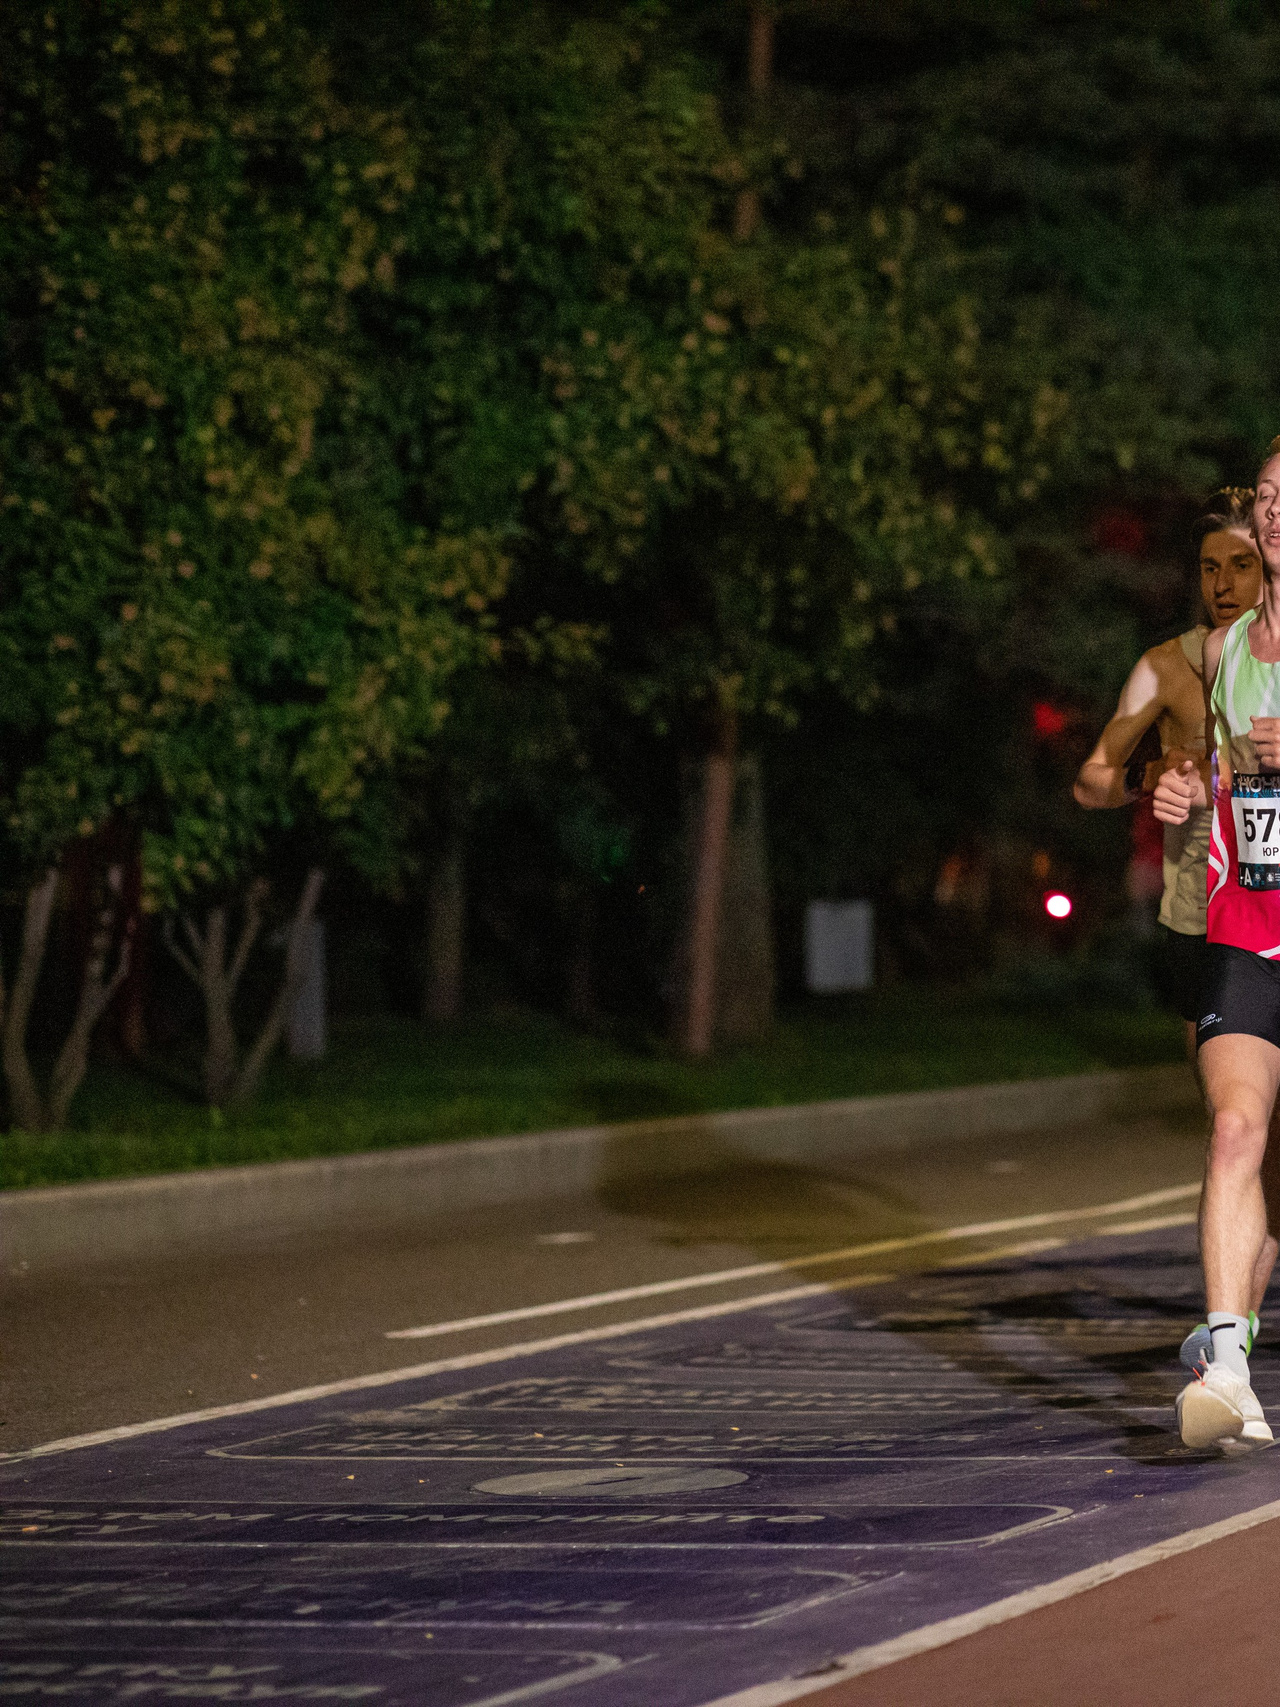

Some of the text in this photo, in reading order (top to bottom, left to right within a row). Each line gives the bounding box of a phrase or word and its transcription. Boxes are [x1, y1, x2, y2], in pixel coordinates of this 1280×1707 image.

[0, 1509, 827, 1523] Затем поменяйте
[0, 1524, 157, 1535] огу
